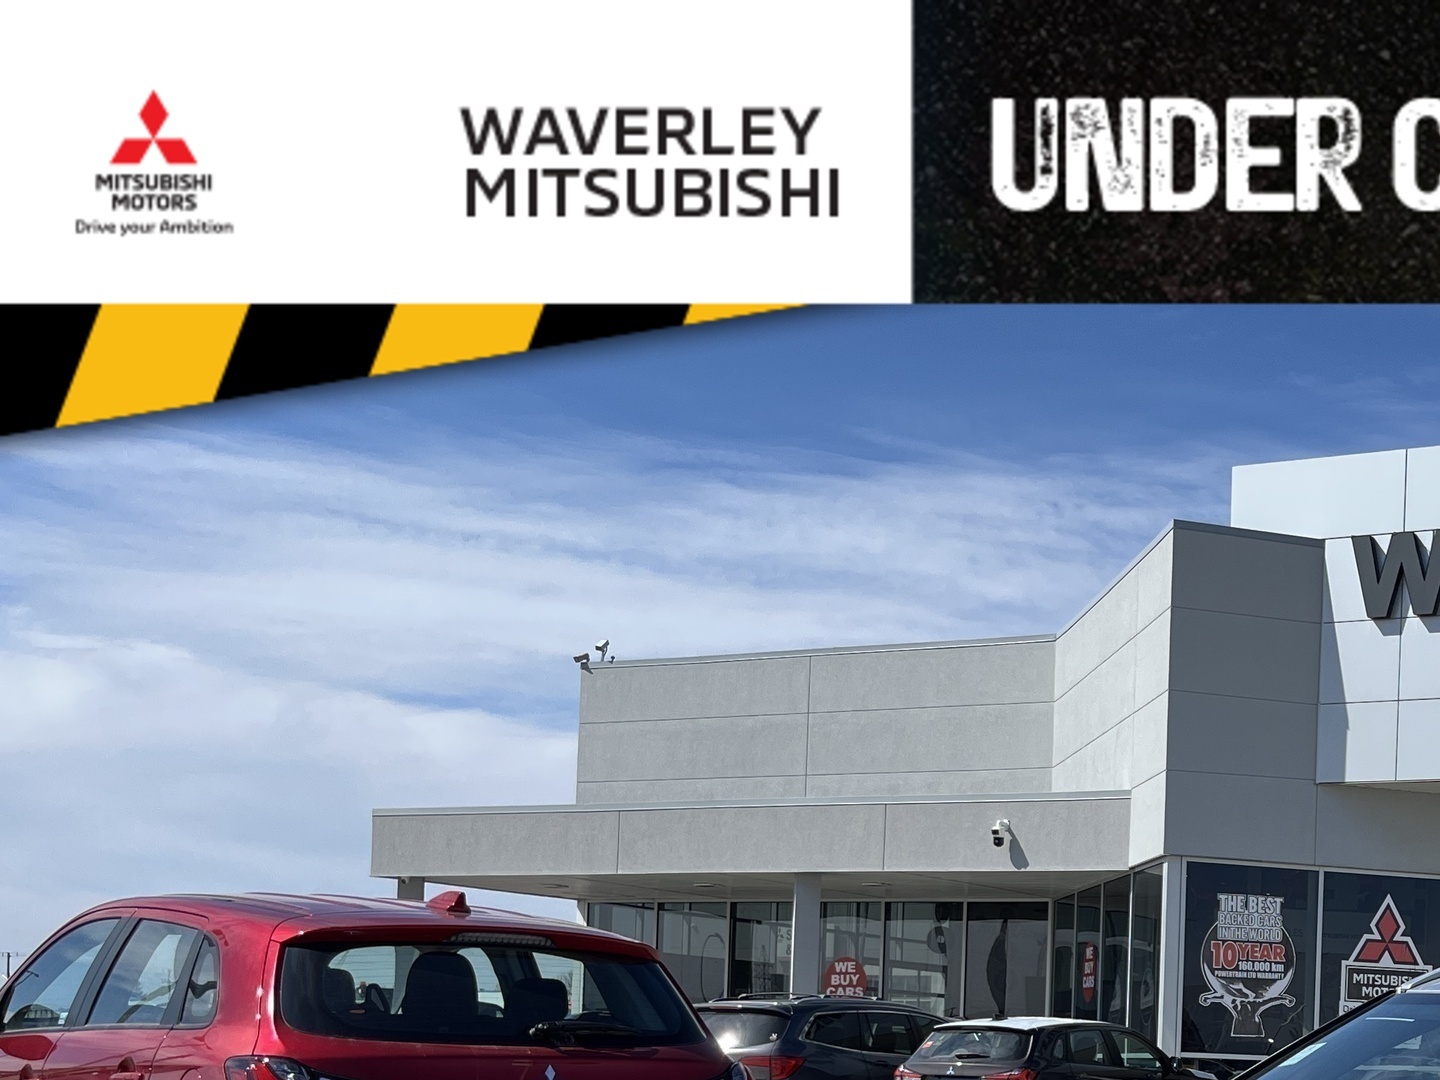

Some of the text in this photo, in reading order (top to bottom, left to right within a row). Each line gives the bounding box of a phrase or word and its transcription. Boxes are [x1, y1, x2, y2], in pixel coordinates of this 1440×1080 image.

[1218, 894, 1284, 914] THE BEST
[1219, 913, 1282, 928] BACKED CARS
[1229, 927, 1247, 940] THE
[1249, 928, 1282, 941] WORLD
[1211, 941, 1286, 969] 10 YEAR
[835, 962, 856, 972] WE
[1271, 963, 1284, 972] km
[831, 974, 860, 985] BUY
[1352, 973, 1413, 986] MITSUBIS
[826, 987, 864, 997] CARS
